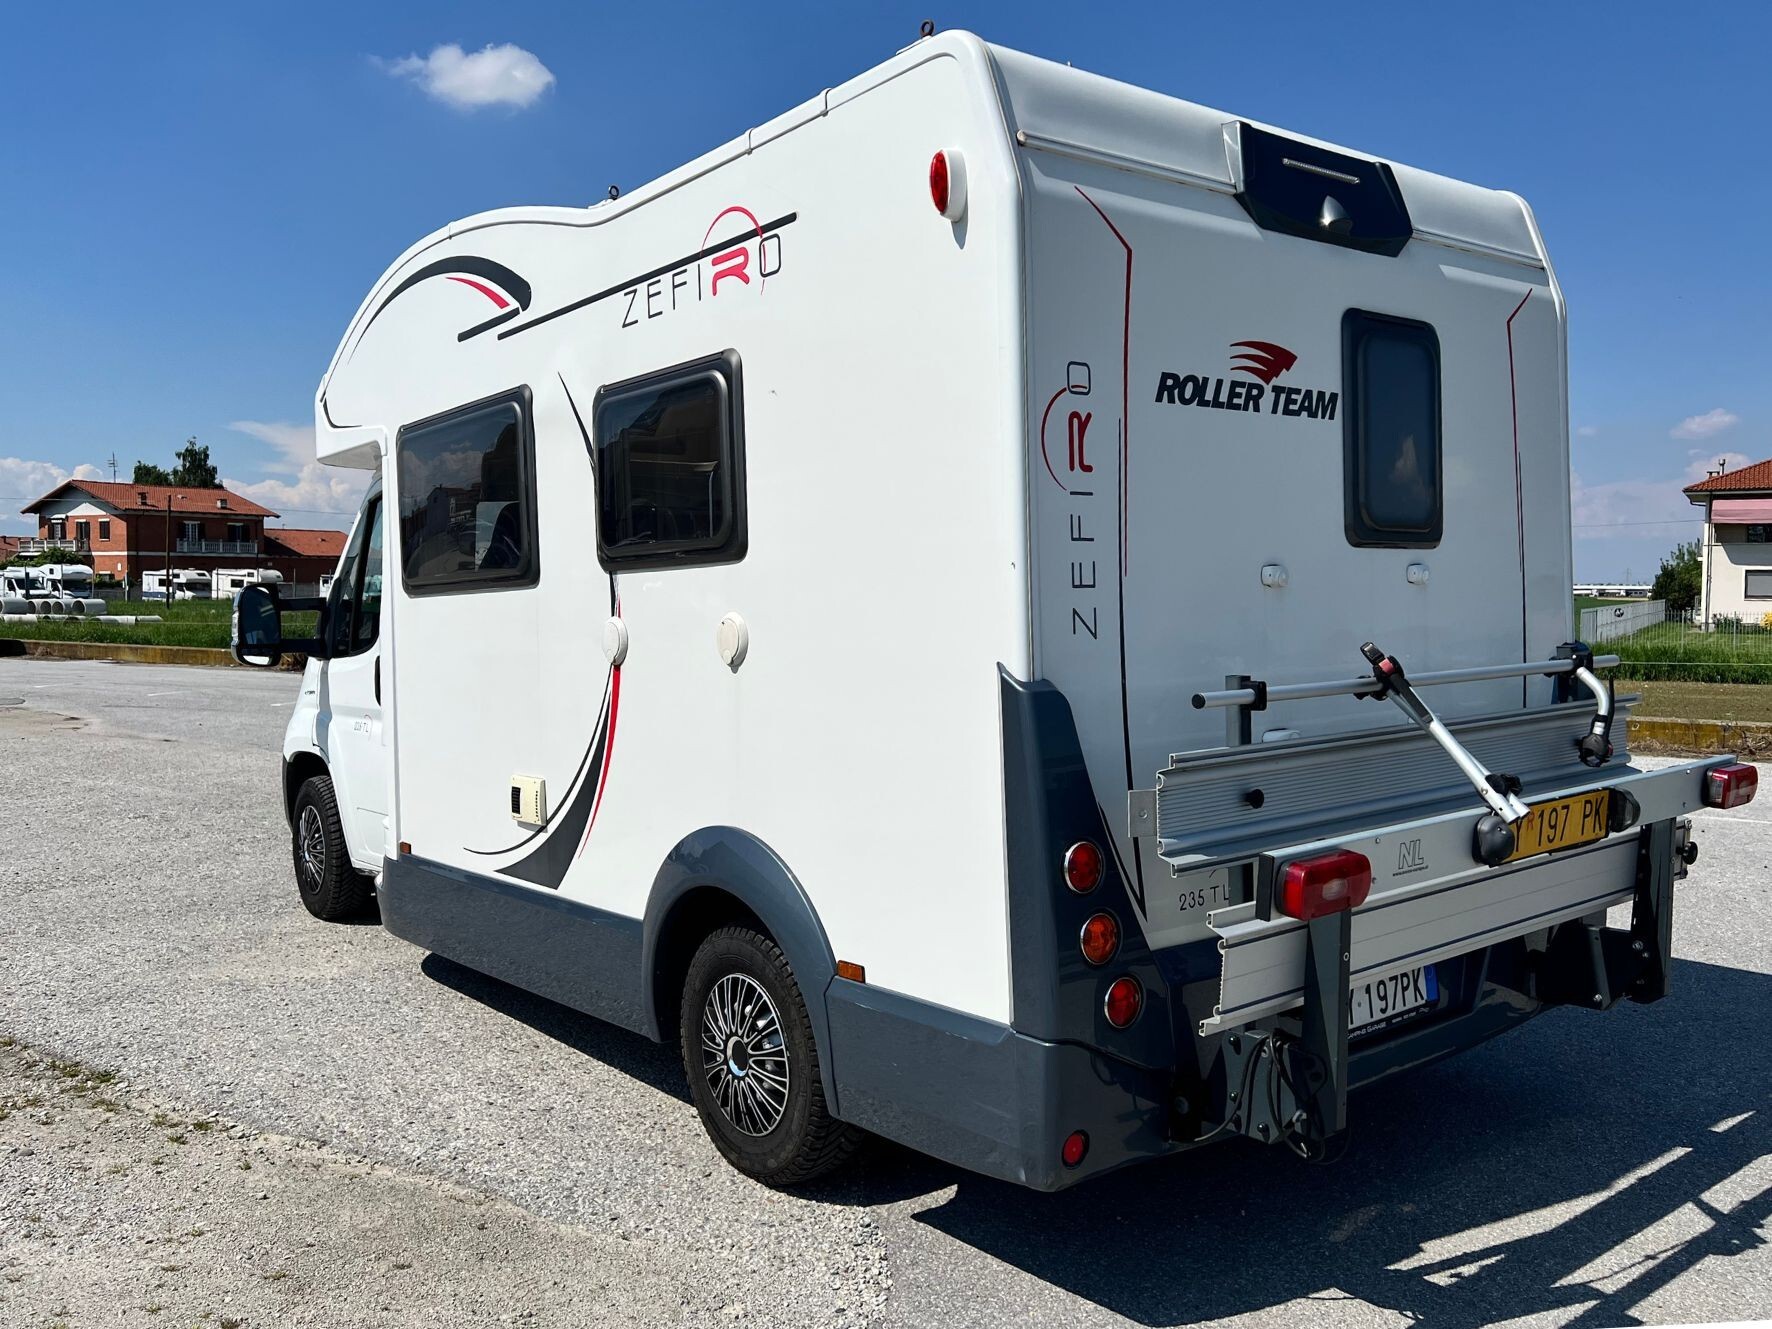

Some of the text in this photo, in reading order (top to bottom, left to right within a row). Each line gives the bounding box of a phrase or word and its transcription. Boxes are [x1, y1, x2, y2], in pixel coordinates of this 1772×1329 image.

[622, 233, 782, 329] ZEFIRO
[1155, 371, 1339, 421] ROLLER TEAM
[1066, 361, 1098, 640] ZEFIRO
[1538, 804, 1570, 847] 197
[1581, 796, 1605, 836] PK
[1398, 839, 1425, 870] NL
[1179, 884, 1230, 911] 235 TL
[1365, 967, 1425, 1019] 197PK
